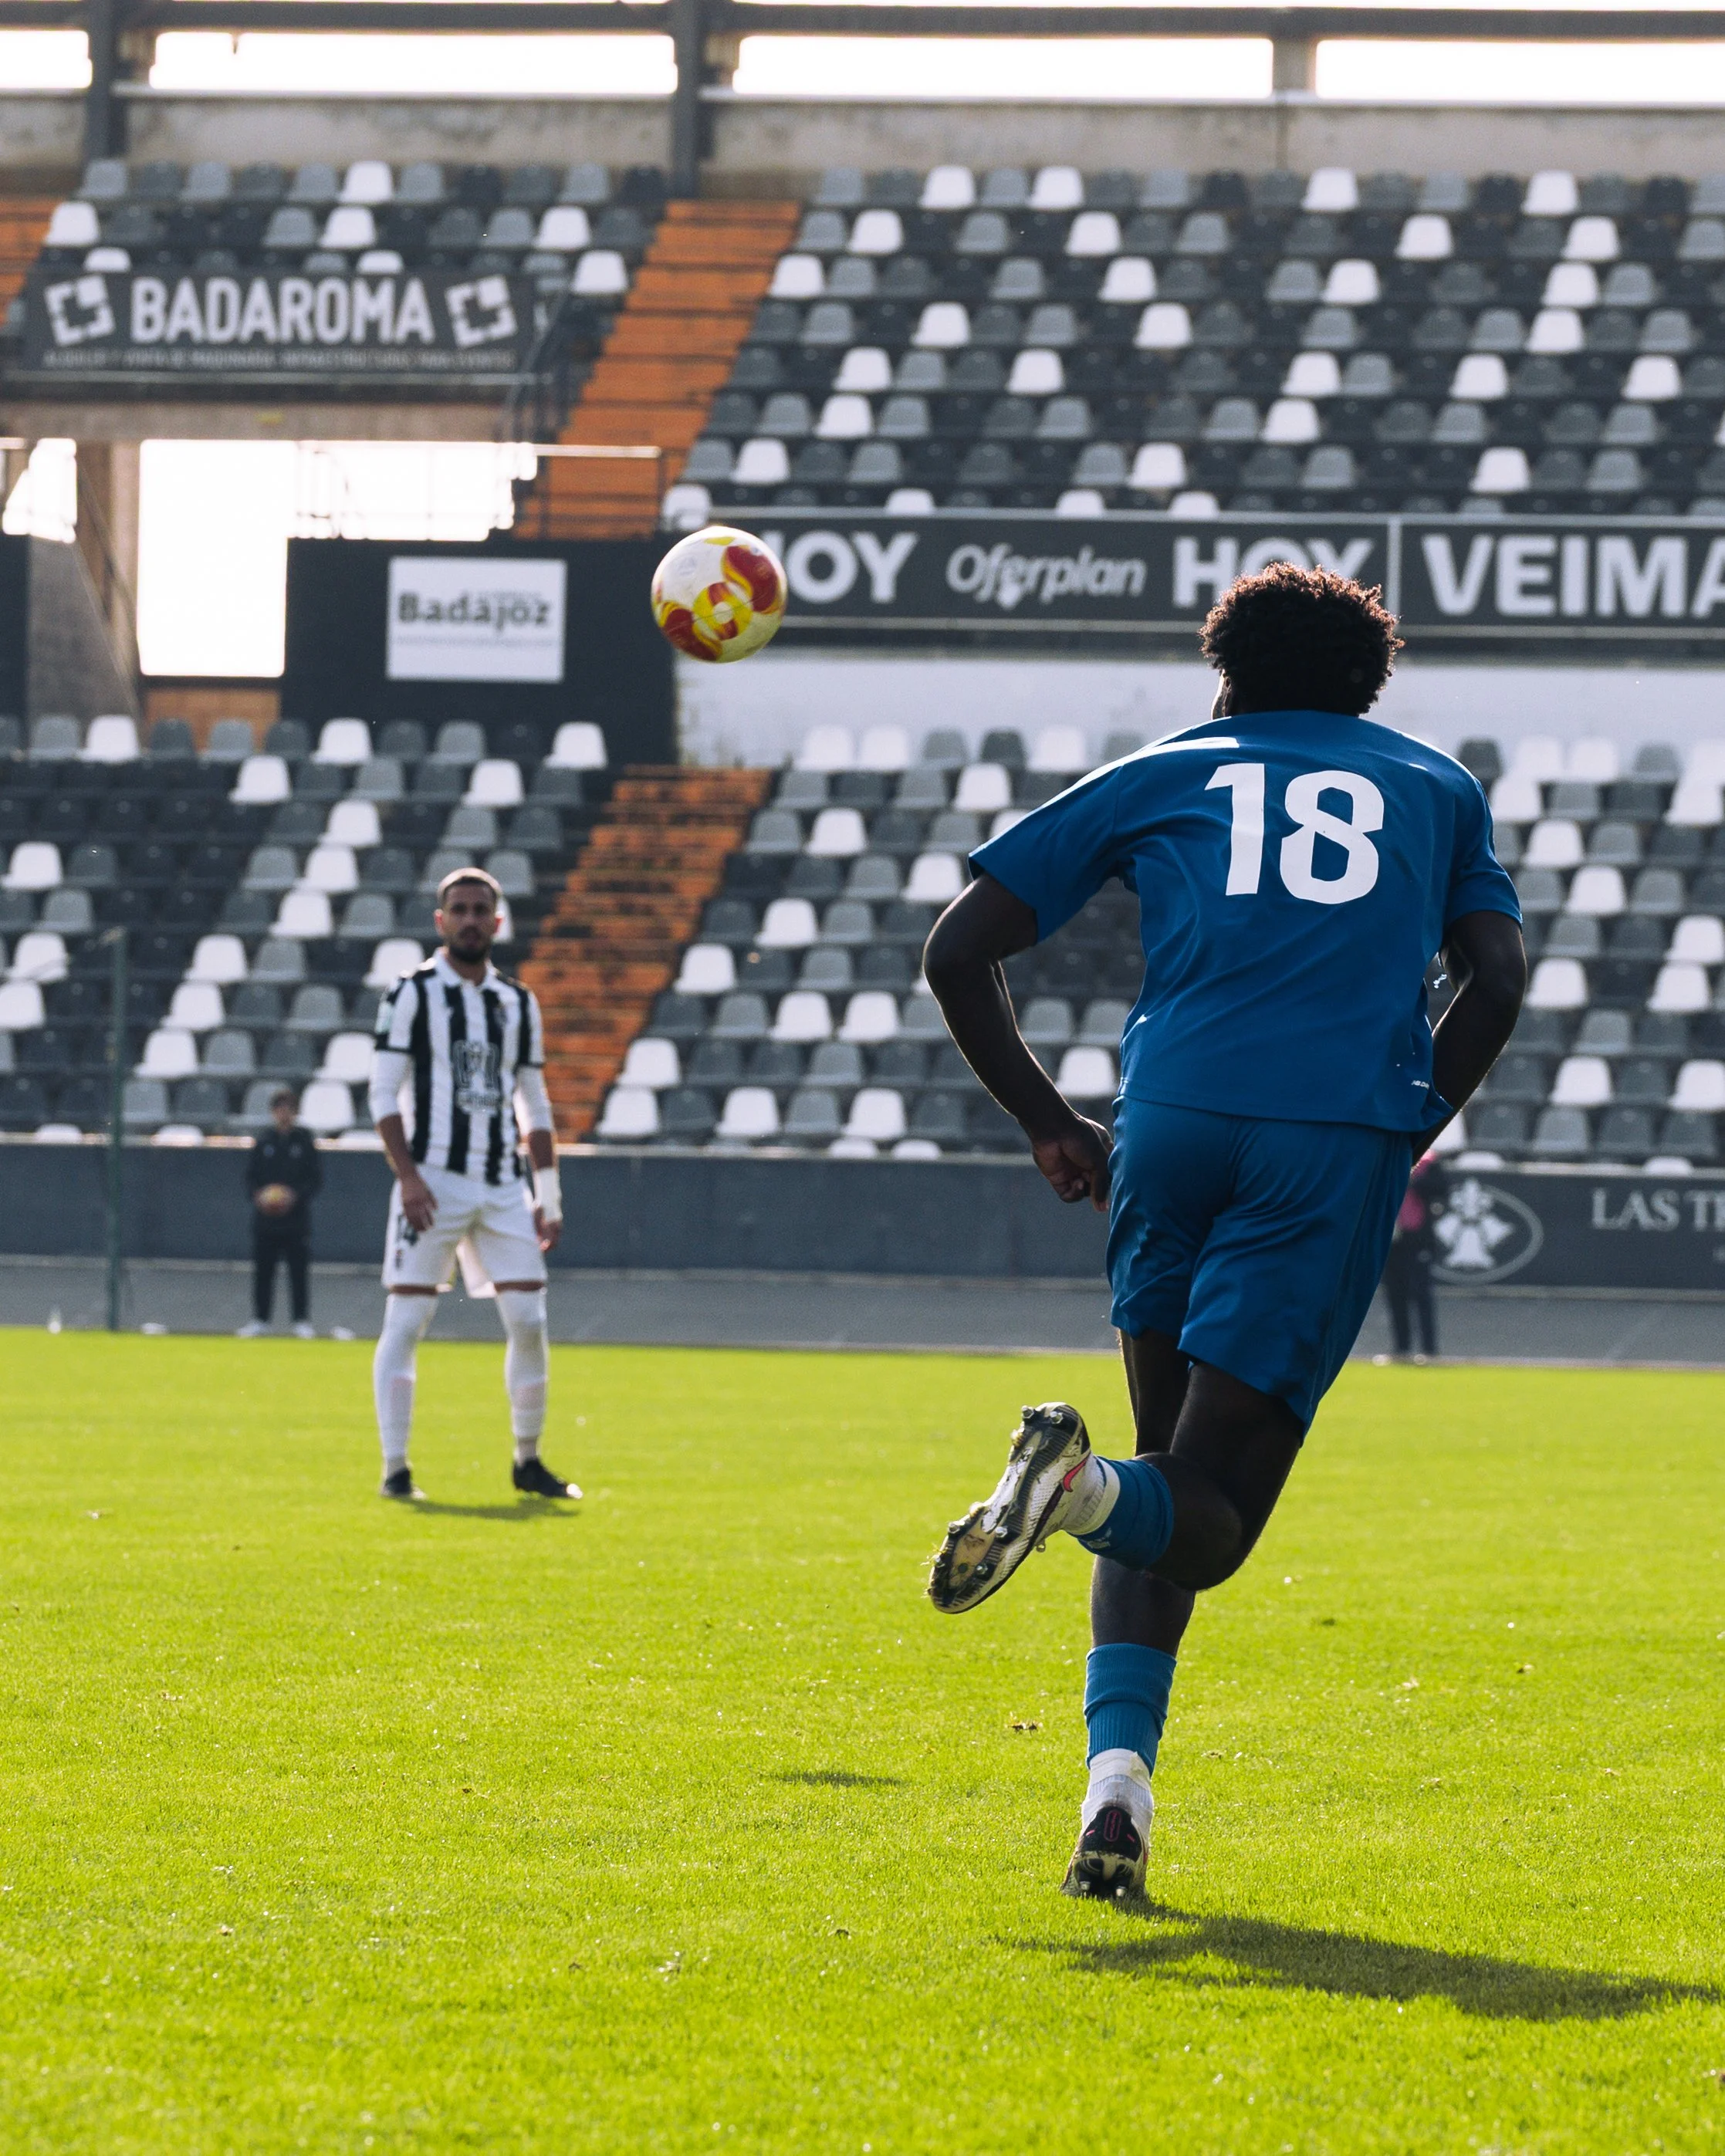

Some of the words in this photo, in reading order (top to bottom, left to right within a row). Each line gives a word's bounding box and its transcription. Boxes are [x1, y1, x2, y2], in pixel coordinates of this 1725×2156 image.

[130, 276, 435, 345] BADAROMA
[398, 589, 551, 634] Badajoz
[1204, 762, 1385, 904] 18
[1591, 1187, 1680, 1232] LAS
